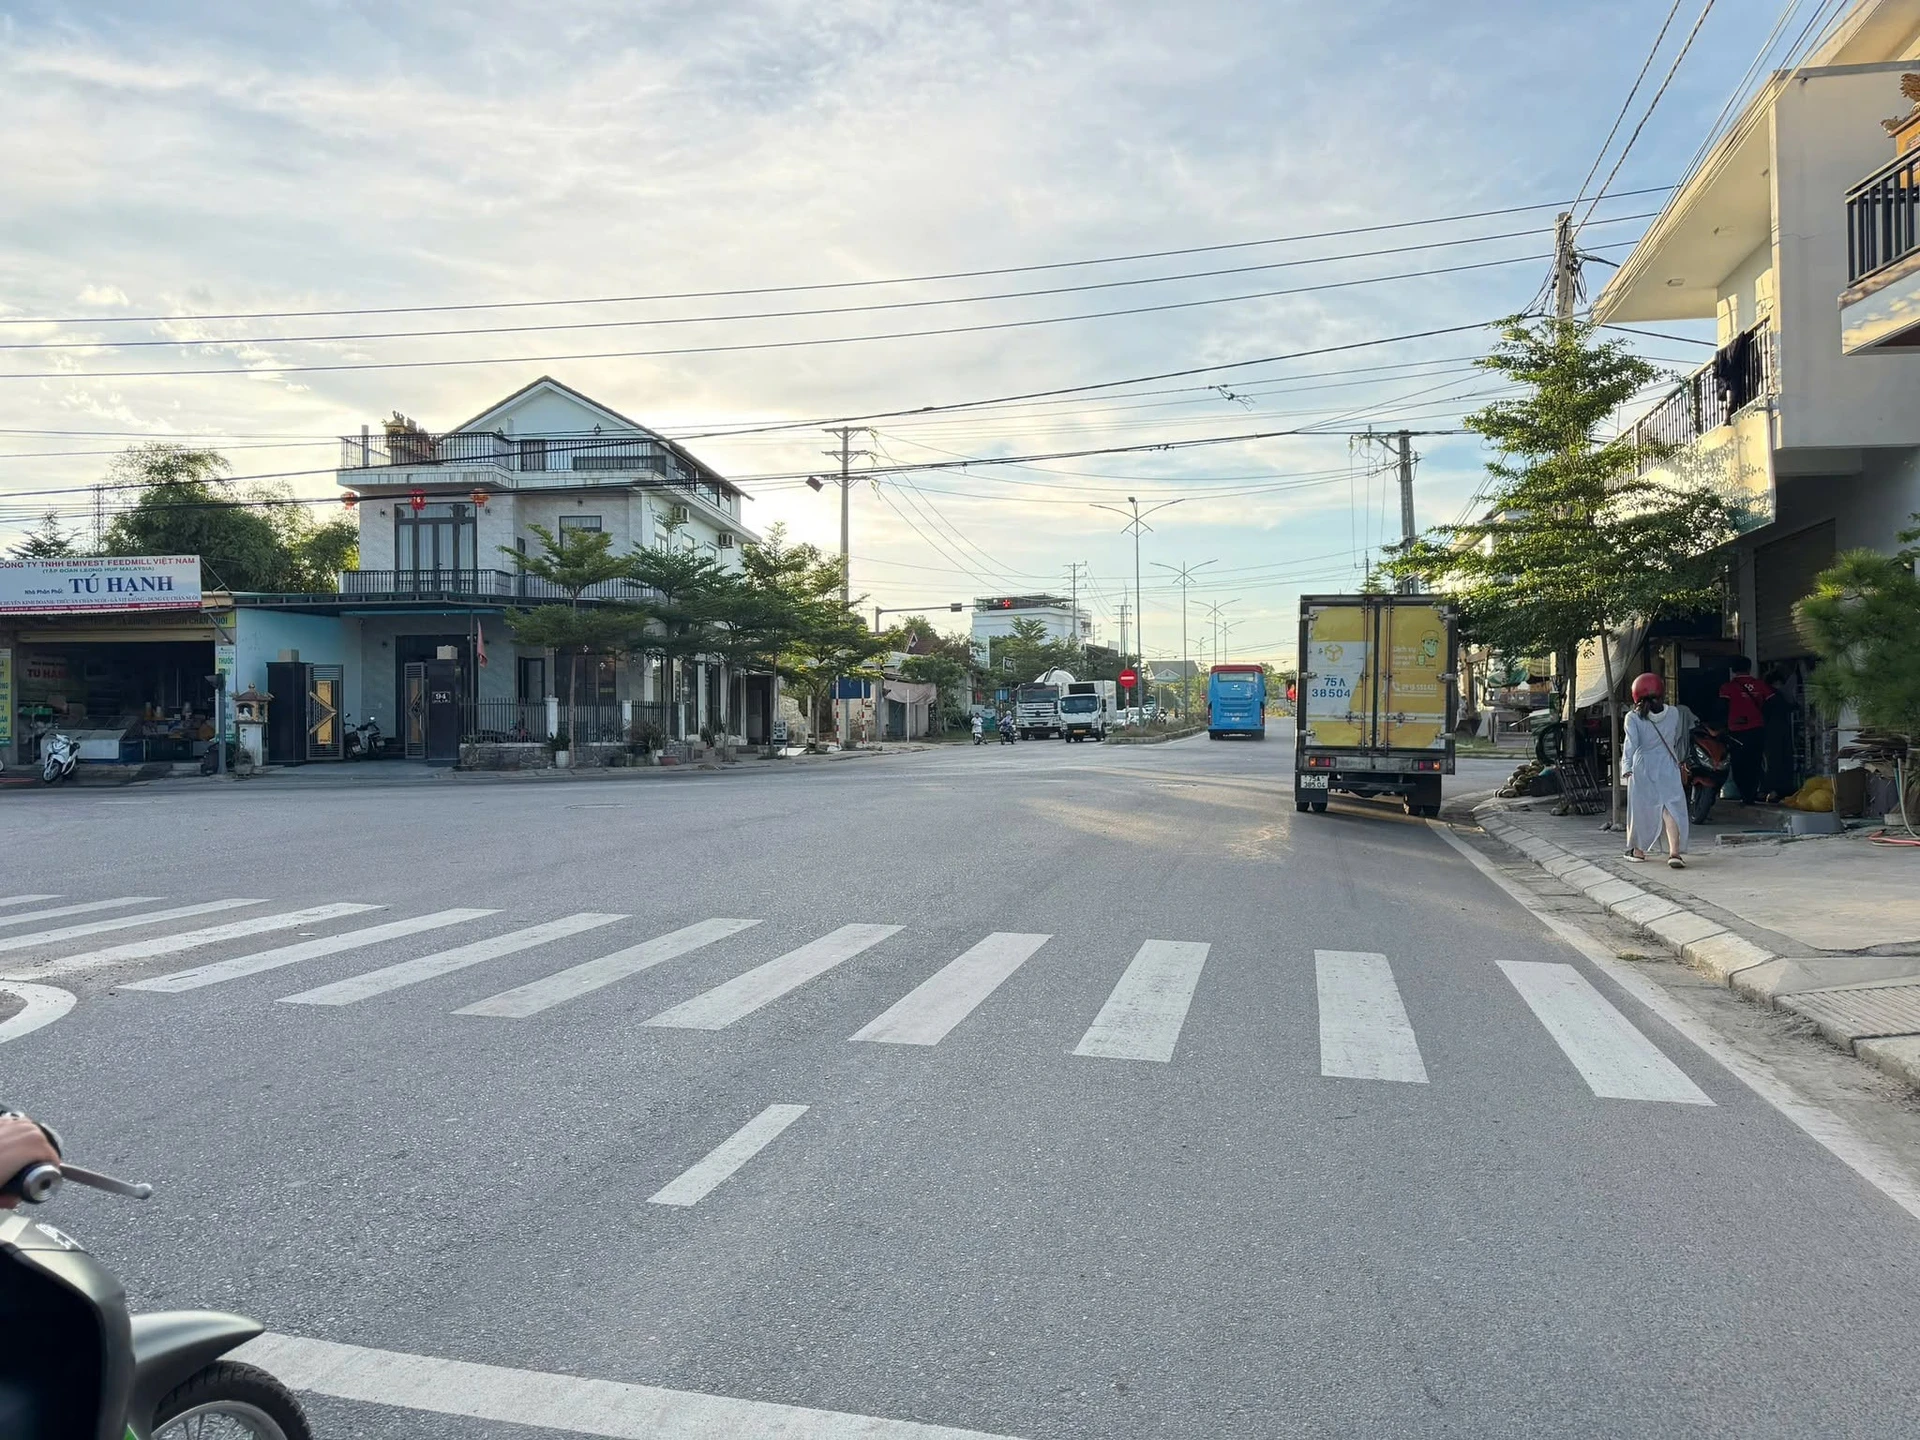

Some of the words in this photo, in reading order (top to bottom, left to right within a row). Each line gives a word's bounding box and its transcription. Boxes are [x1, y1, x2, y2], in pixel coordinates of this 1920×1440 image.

[107, 558, 152, 566] FEEDMILL
[153, 557, 173, 566] VIỆT
[175, 557, 195, 565] NAM
[68, 573, 100, 594] TÚ
[106, 575, 174, 596] HẠNH
[1311, 688, 1351, 698] 38504
